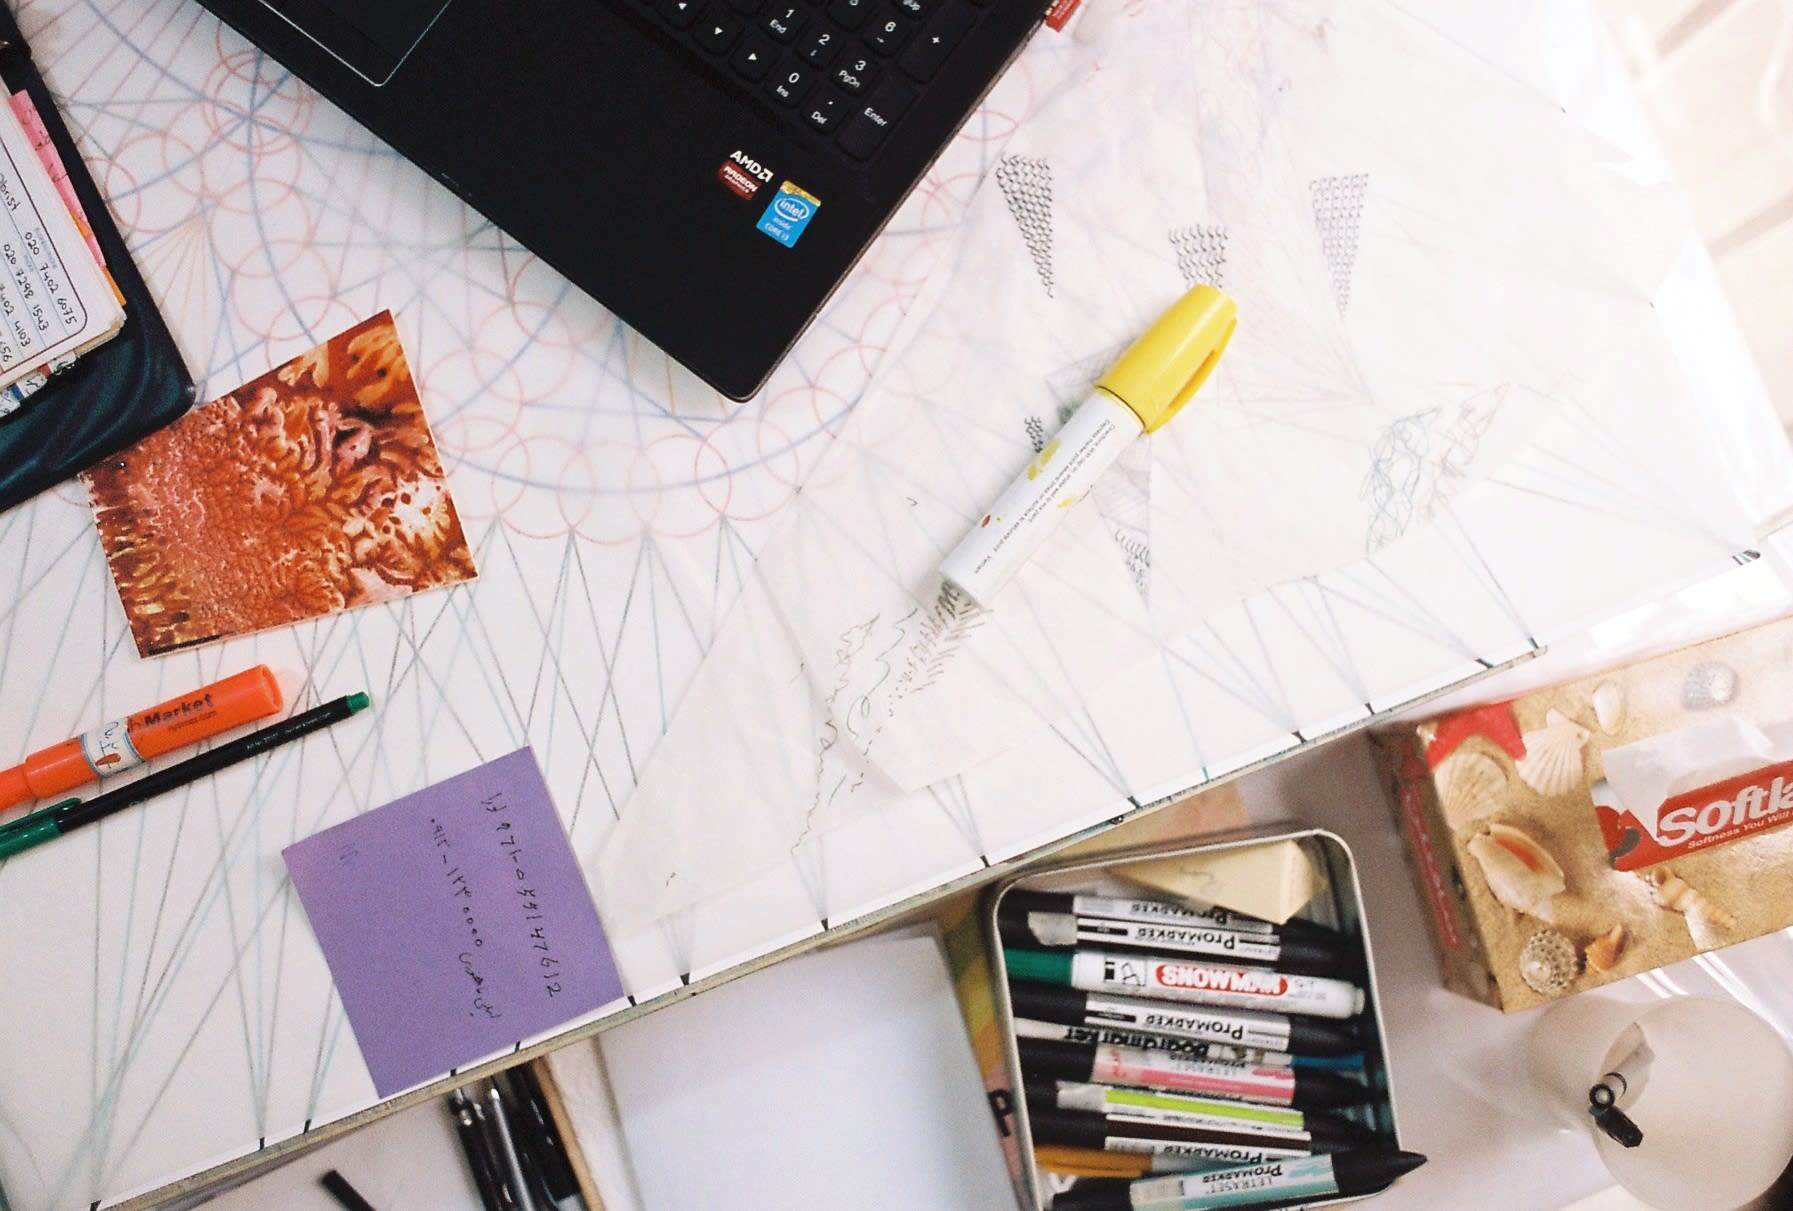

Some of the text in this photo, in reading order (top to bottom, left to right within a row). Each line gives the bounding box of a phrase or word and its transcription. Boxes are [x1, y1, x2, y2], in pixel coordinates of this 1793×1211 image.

[786, 9, 795, 18] 1
[818, 34, 831, 46] 2
[788, 72, 800, 84] 0
[855, 60, 867, 71] 3
[729, 150, 762, 175] AMD
[4, 244, 17, 265] 020
[25, 231, 40, 255] 020
[39, 263, 60, 294] 7402
[57, 297, 78, 325] 6075
[14, 320, 31, 347] 4103
[144, 693, 214, 726] Market
[1687, 827, 1740, 850] Softness
[1743, 820, 1765, 831] You
[1160, 964, 1284, 995] SNOWMAN
